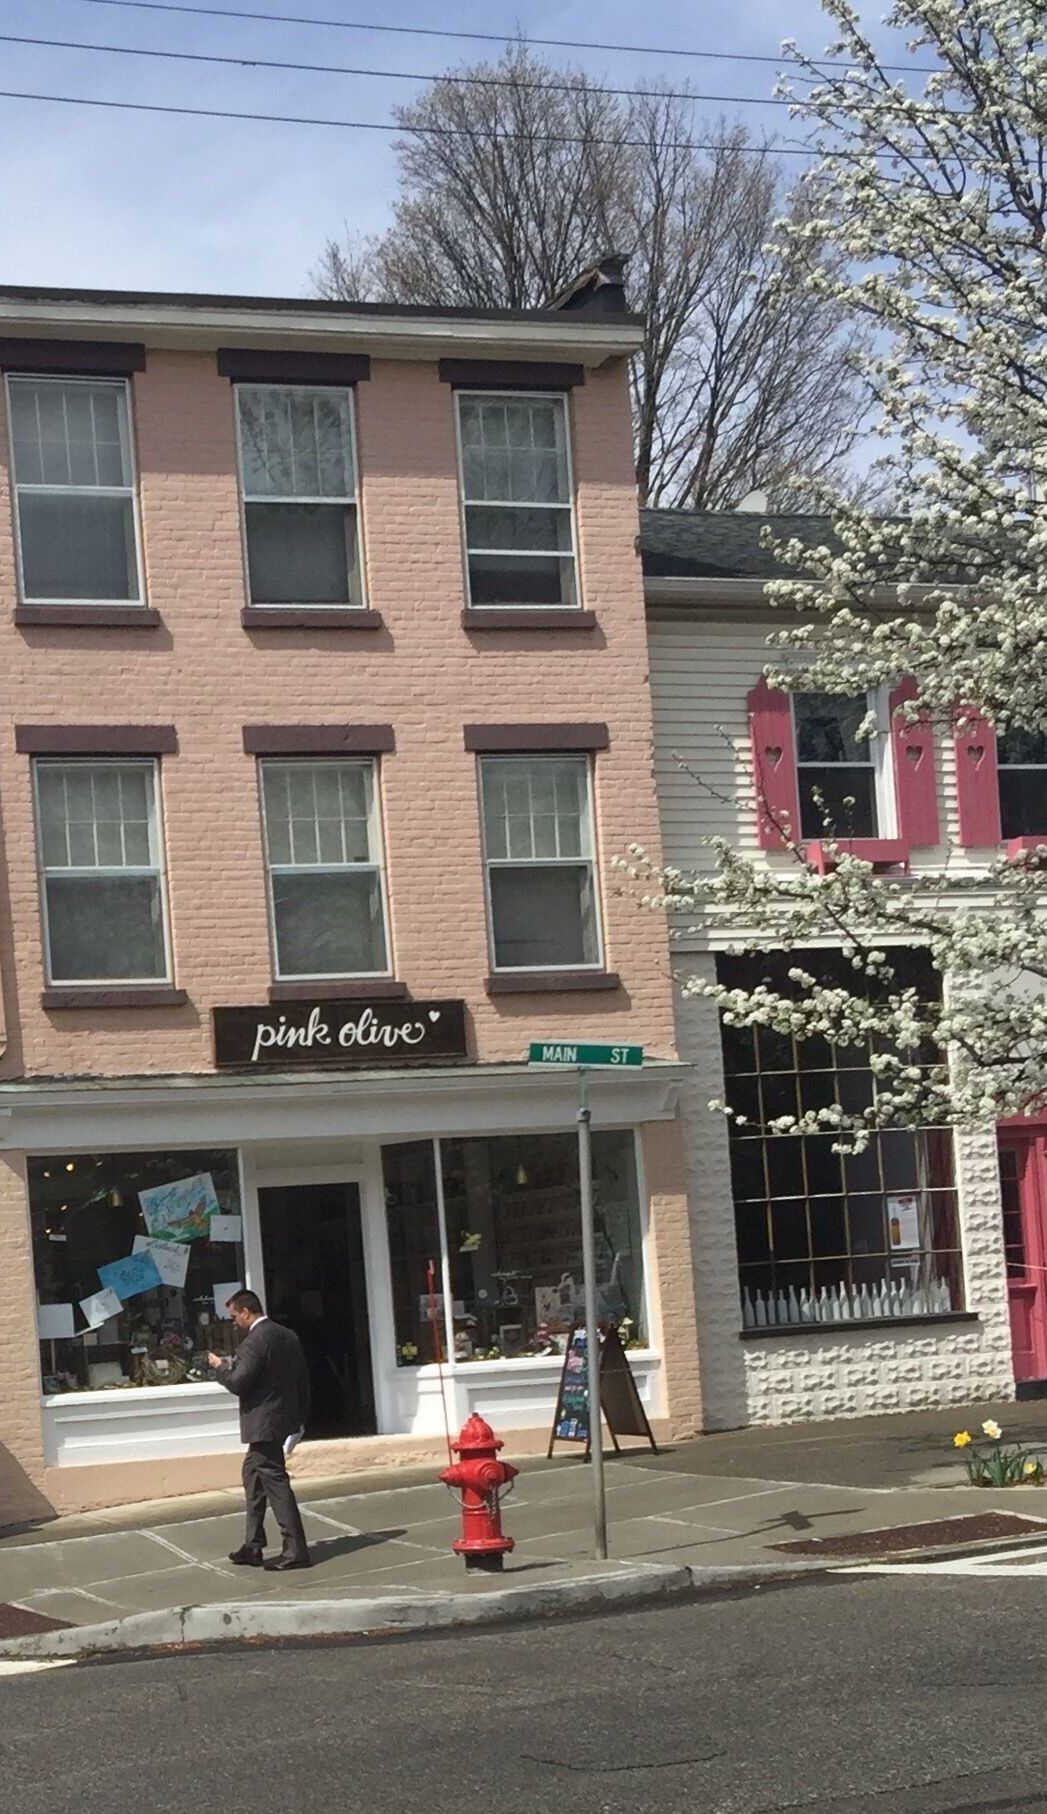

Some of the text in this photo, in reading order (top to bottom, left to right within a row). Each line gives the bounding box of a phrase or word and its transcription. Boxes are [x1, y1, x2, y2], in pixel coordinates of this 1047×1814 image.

[251, 1007, 425, 1061] pink olive
[542, 1045, 630, 1064] MAIN ST
